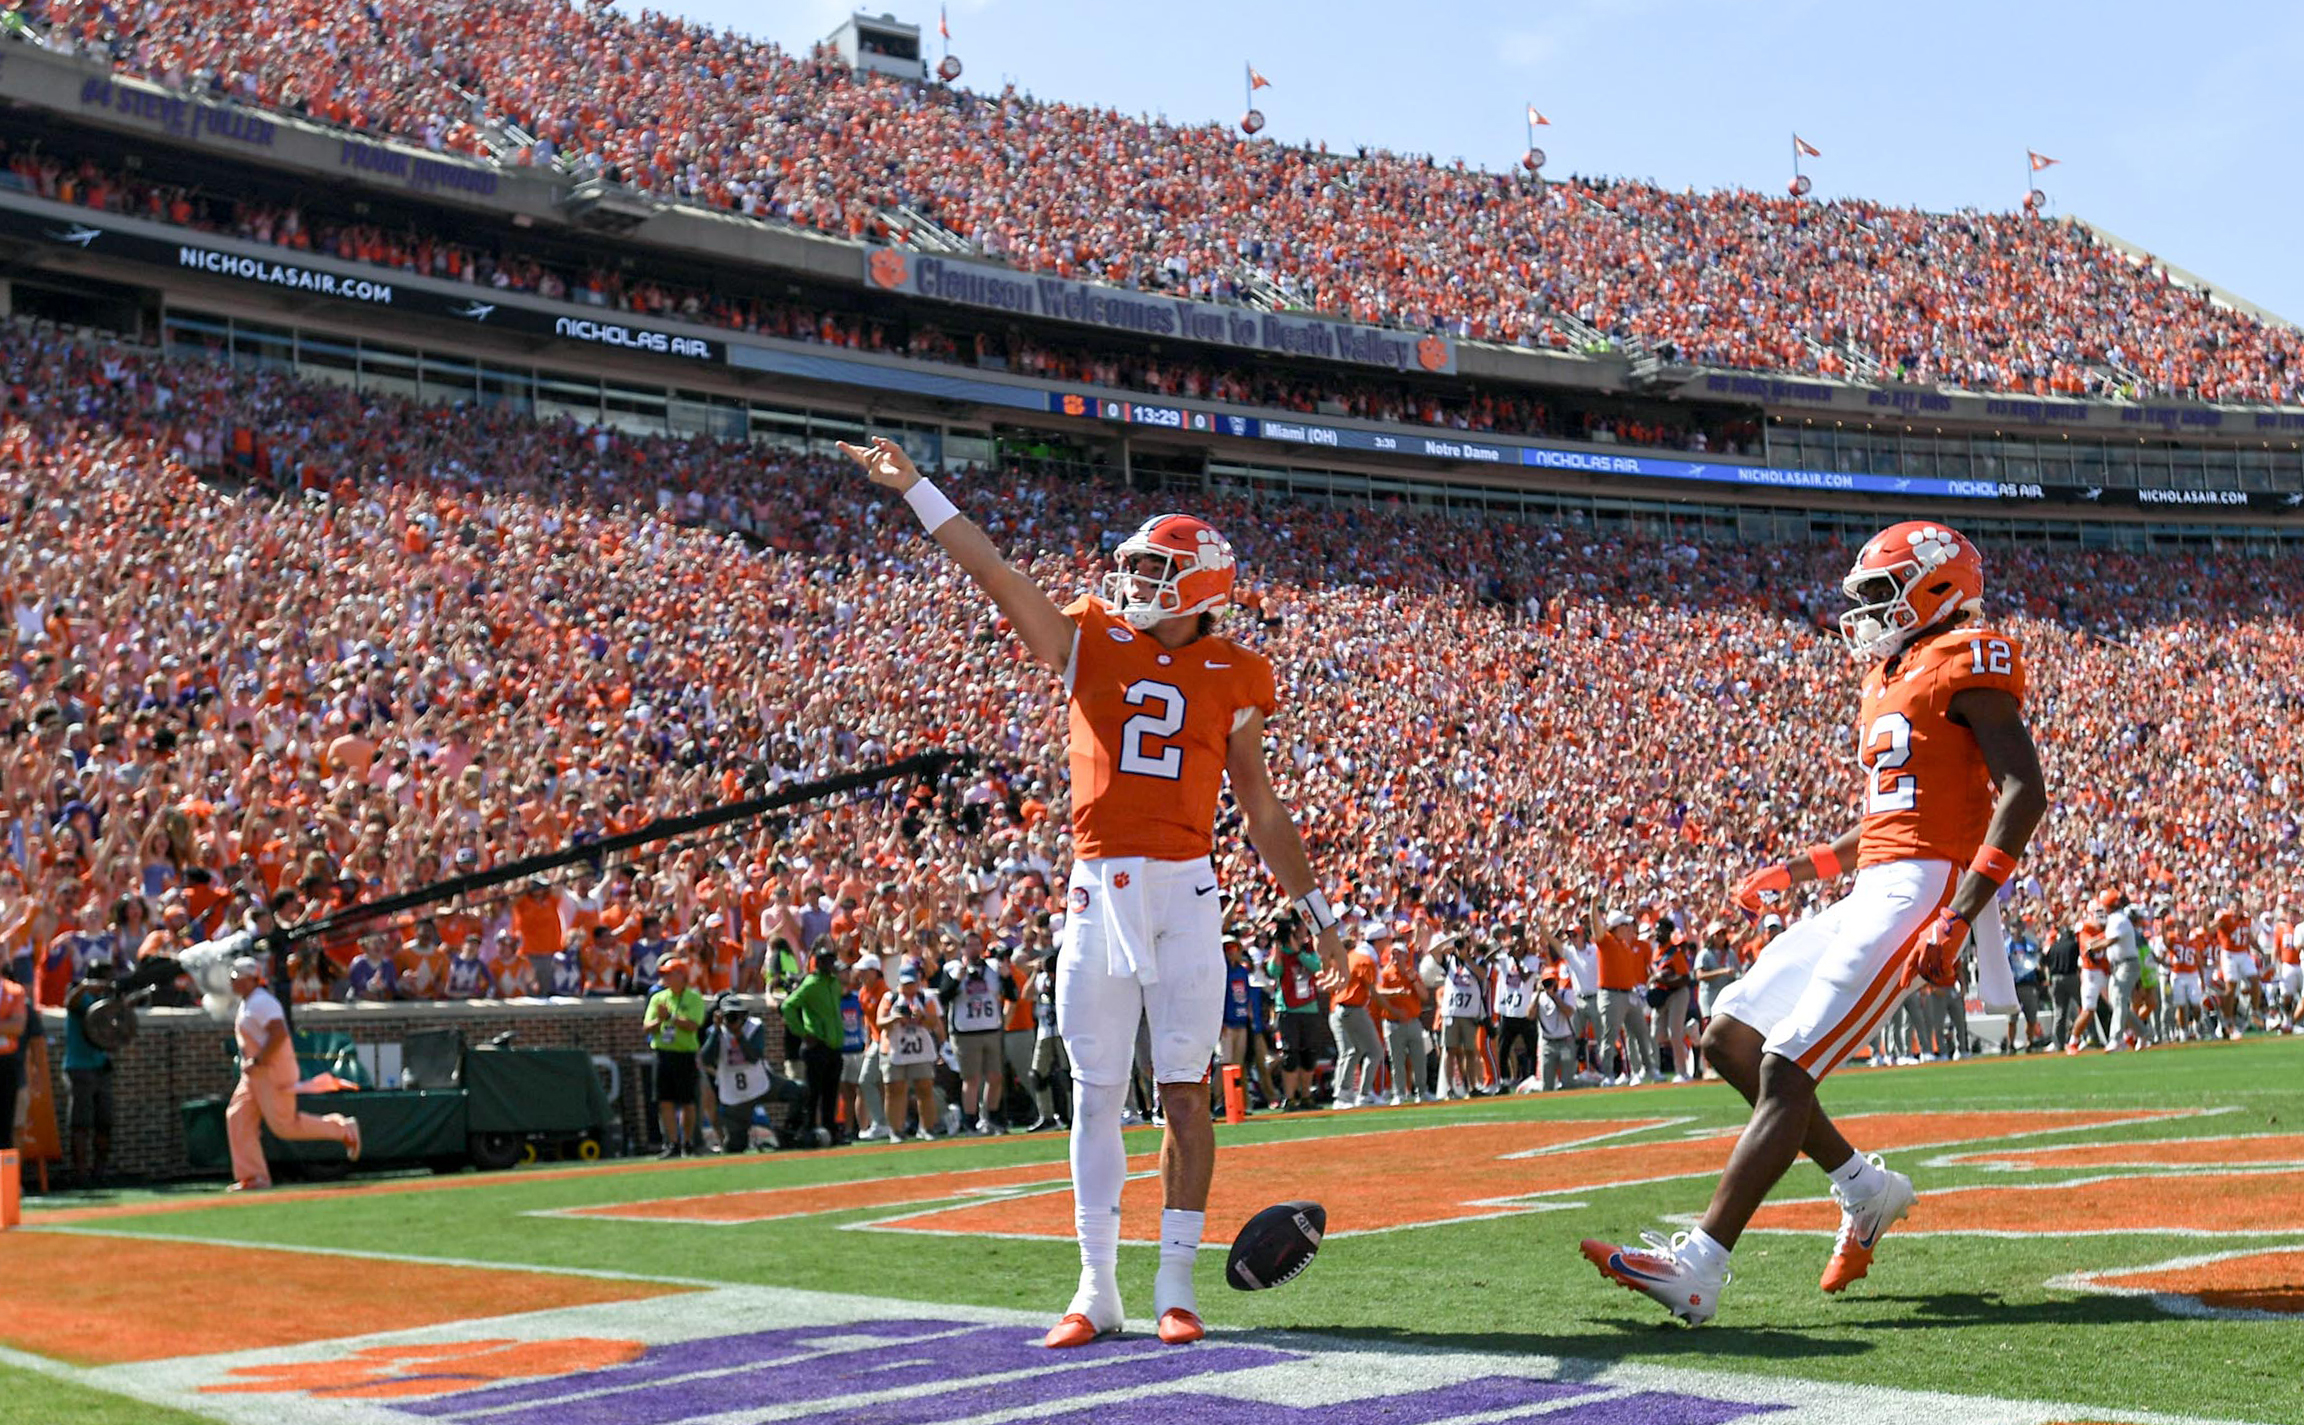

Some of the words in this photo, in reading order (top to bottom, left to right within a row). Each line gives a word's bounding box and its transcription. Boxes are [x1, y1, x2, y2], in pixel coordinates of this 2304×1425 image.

[178, 246, 393, 304] NICHOLASAIR.COM
[915, 257, 1034, 313] Clemson
[1037, 278, 1176, 335] Welcomes
[1176, 302, 1226, 342] You
[1228, 311, 1257, 346] to
[1262, 315, 1334, 358] Death
[1336, 325, 1410, 372] Valley
[555, 316, 669, 352] NICHOLAS
[1107, 402, 1119, 418] 0
[1133, 405, 1181, 427] 13:29
[1194, 414, 1206, 429] 0
[1265, 423, 1305, 441] Miami
[1307, 427, 1338, 448] (OH)
[1374, 436, 1397, 450] 3:30
[1425, 440, 1461, 457] Notre
[1463, 444, 1500, 462] Dame
[1535, 451, 1611, 471] NICHOLAS
[1738, 468, 1854, 488] NICHOLASAIR.COM
[1948, 479, 2018, 498] NICHOLAS
[2139, 488, 2248, 505] NICHOLASAIR.COM
[1969, 638, 2012, 676] 12
[1118, 678, 1187, 781] 2
[735, 1072, 748, 1091] 8
